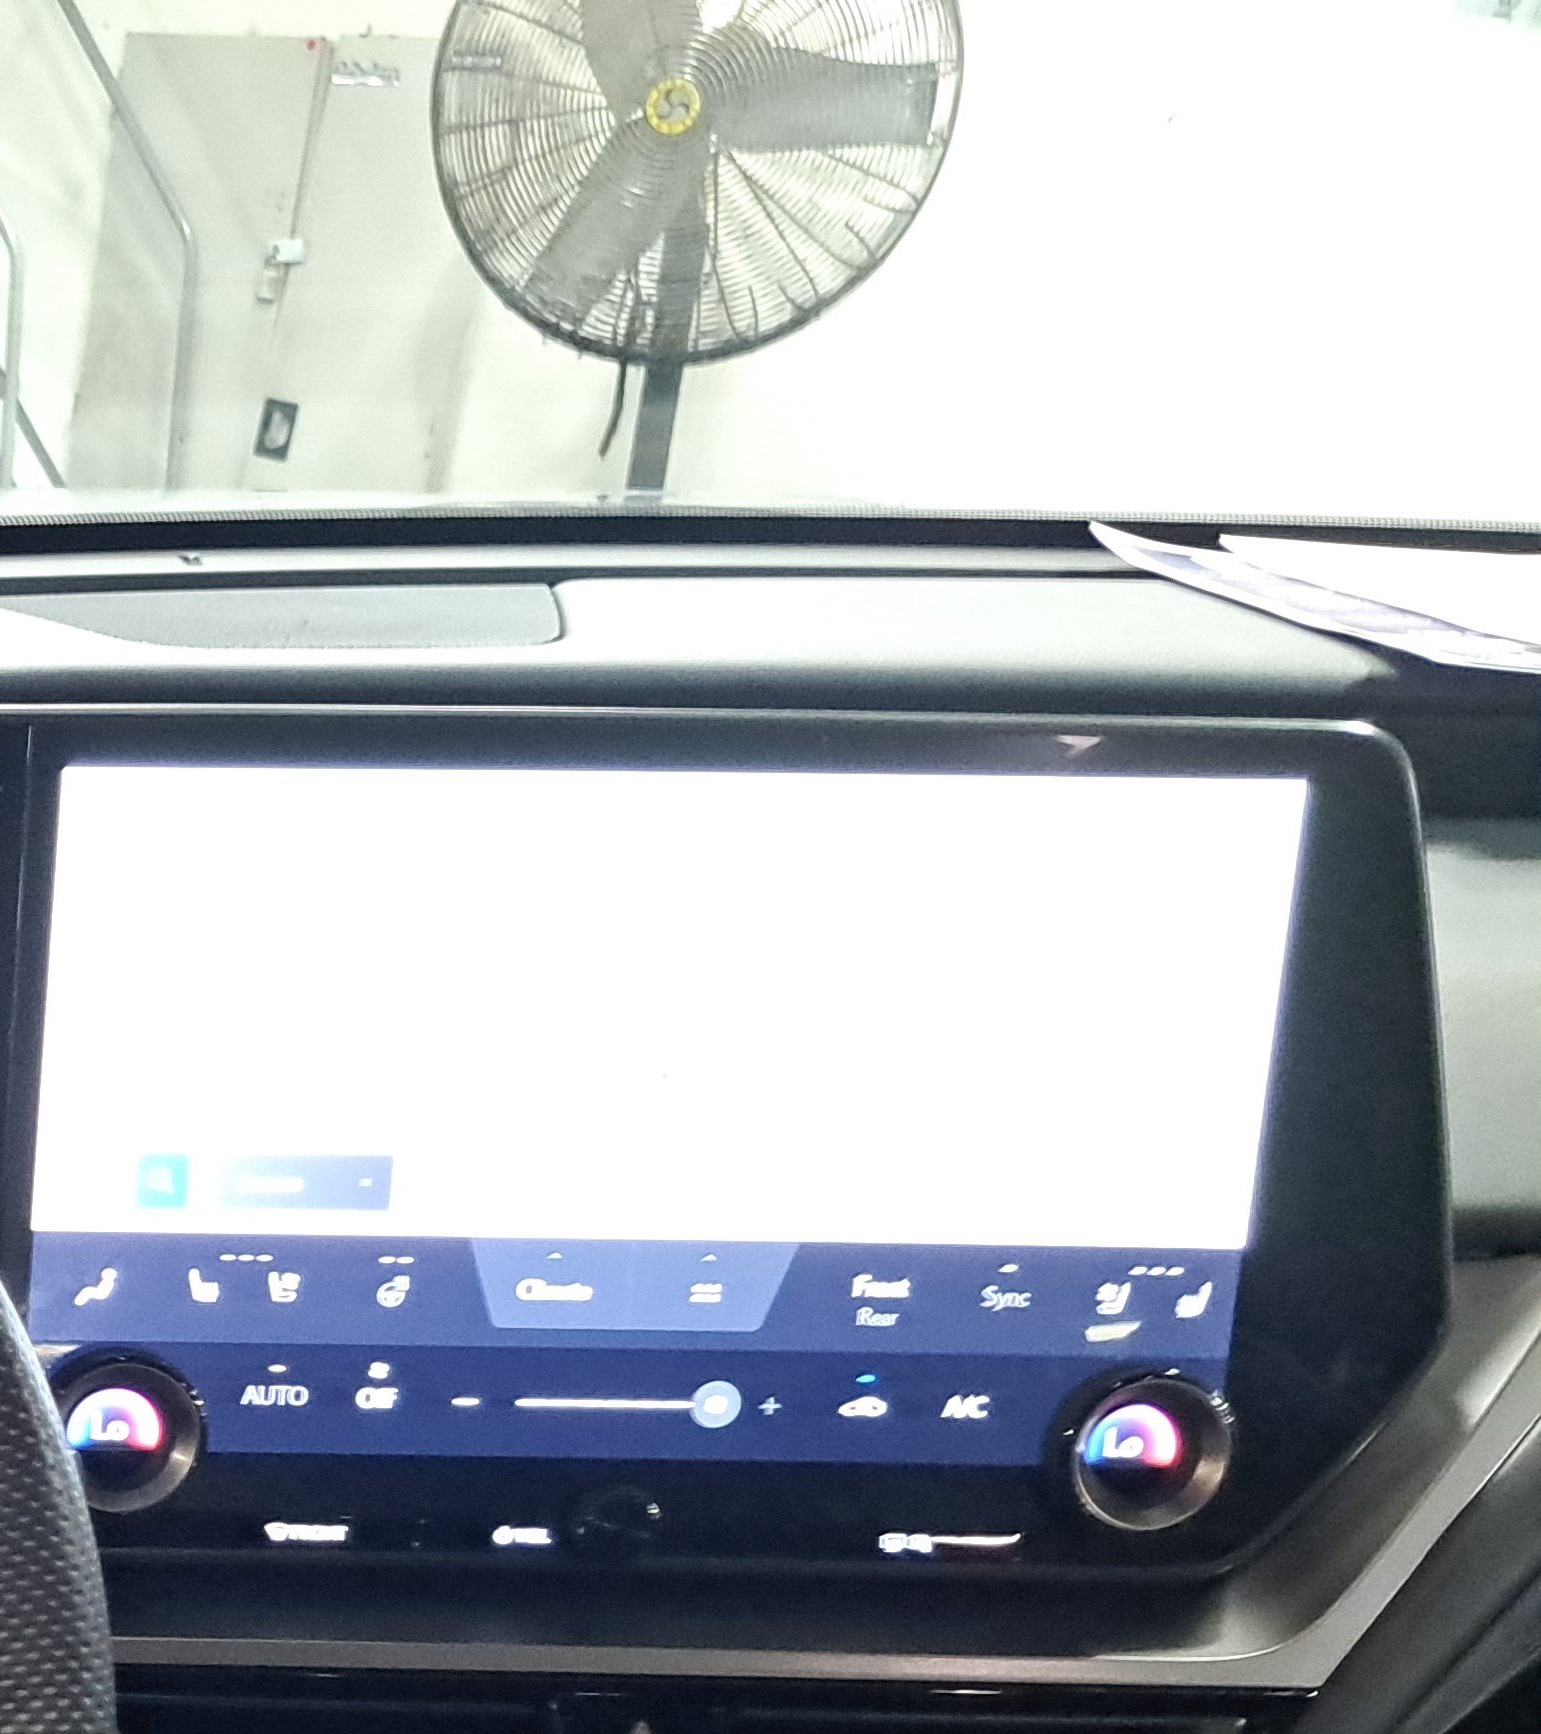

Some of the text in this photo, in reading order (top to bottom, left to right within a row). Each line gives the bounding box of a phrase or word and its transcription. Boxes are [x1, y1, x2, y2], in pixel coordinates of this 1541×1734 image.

[979, 1285, 1032, 1312] Sync
[856, 1306, 900, 1327] Rear
[240, 1385, 310, 1408] AUTO
